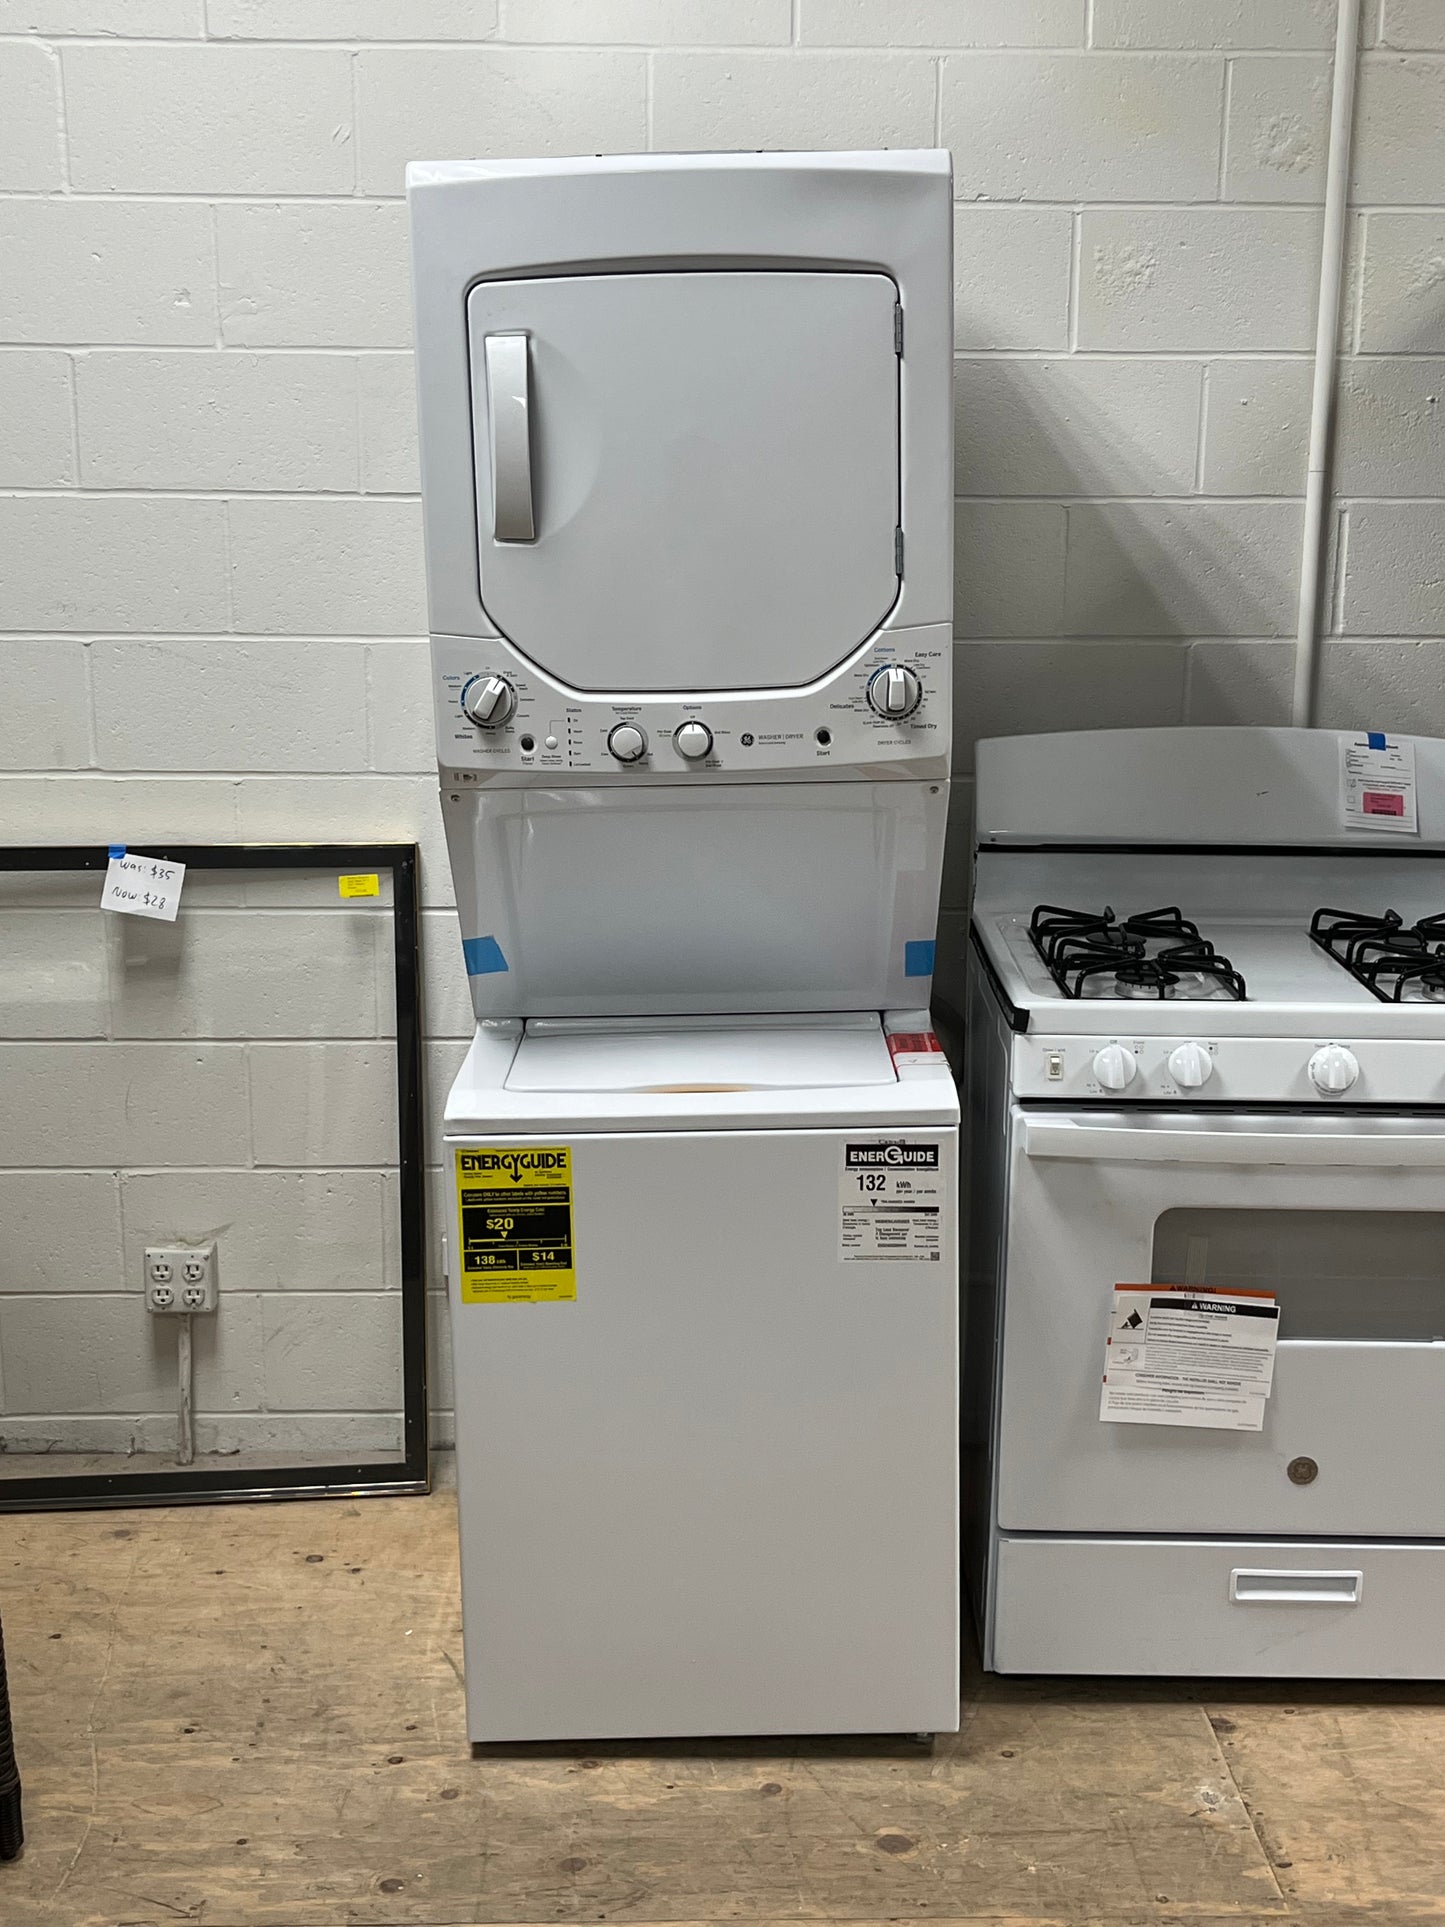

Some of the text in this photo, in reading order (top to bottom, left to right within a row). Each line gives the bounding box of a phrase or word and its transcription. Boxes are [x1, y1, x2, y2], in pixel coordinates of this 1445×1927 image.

[150, 864, 176, 880] $35
[143, 892, 166, 910] $28
[461, 1152, 567, 1172] ENERGYGUIDE
[850, 1146, 934, 1164] ENERGUIDE
[856, 1174, 886, 1191] 132
[486, 1218, 514, 1230] $20
[474, 1255, 496, 1265] 138
[532, 1251, 555, 1261] $14
[1199, 1303, 1236, 1313] WARNING
